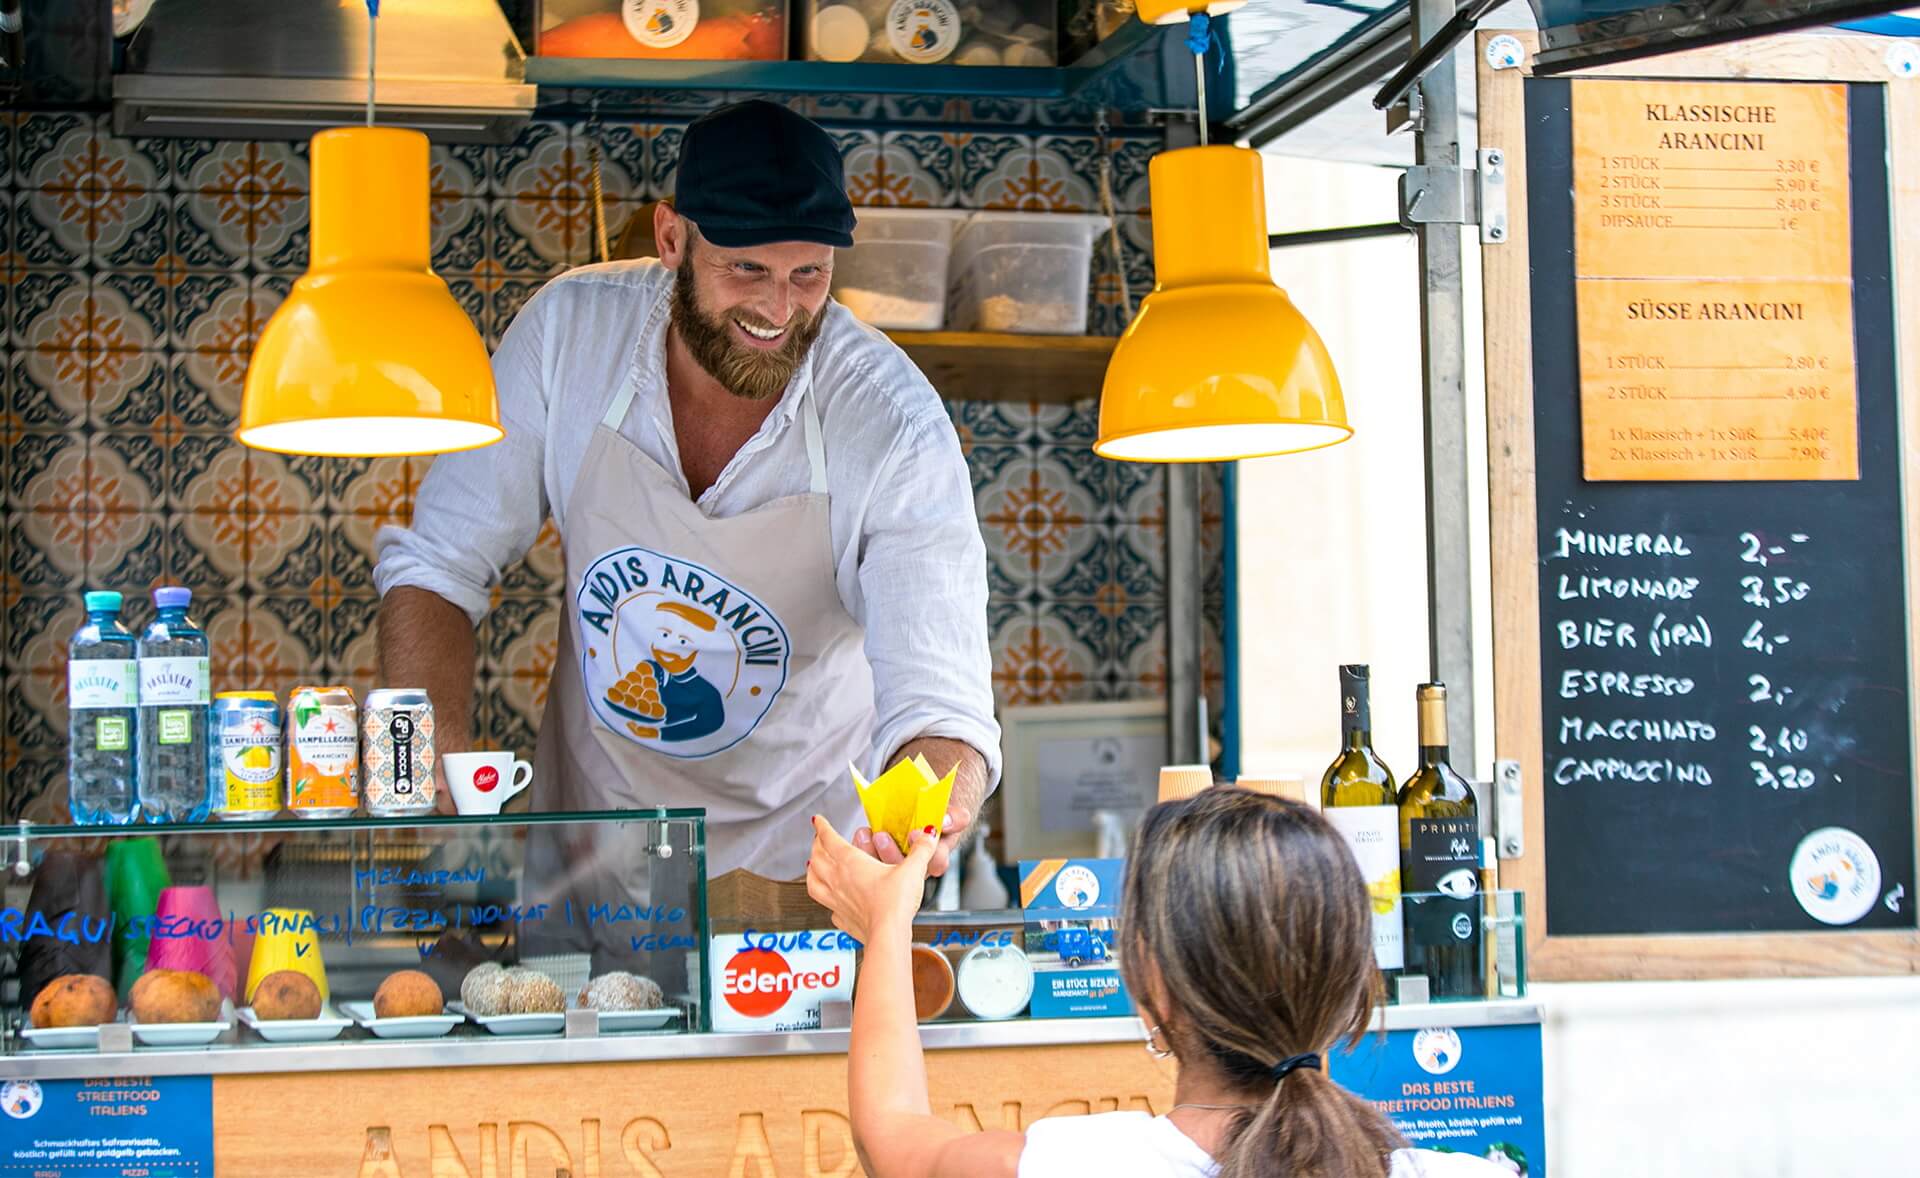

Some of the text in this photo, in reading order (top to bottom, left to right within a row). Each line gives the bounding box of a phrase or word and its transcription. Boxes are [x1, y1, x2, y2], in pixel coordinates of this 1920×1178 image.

[1646, 103, 1776, 123] KLASSISCHE
[1658, 132, 1765, 151] ARANCINI
[1600, 157, 1608, 169] 1
[1612, 155, 1660, 170] STÜCK
[1600, 176, 1609, 189] 2
[1612, 174, 1660, 190] STÜCK
[1600, 195, 1609, 209] 3
[1612, 193, 1661, 209] STÜCK
[1600, 214, 1673, 229] DIPSAUCE
[1628, 298, 1805, 320] SÜSSE ARANCINI
[1617, 354, 1665, 369] STÜCK
[1607, 386, 1616, 399] 2
[1619, 384, 1667, 400] STÜCK
[1609, 428, 1625, 441] 1x
[1629, 427, 1691, 441] Klassisch
[1711, 428, 1727, 441] 1x
[1609, 448, 1627, 461] 2x
[1630, 446, 1693, 461] Klassisch
[1711, 447, 1728, 461] 1x
[1555, 528, 1692, 558] MINERAL
[582, 556, 649, 635] ANDIS
[1557, 573, 1700, 600] LIMONADE
[1557, 618, 1637, 649] BIER
[1559, 669, 1695, 698] ESPRESSO
[1559, 716, 1717, 744] MACCHIATO
[1553, 757, 1713, 785] CAPPUCCINO
[0, 907, 107, 945] RAGU
[361, 904, 448, 937] PIZZA
[587, 902, 686, 926] MANGO
[723, 965, 840, 995] Edenred
[76, 1090, 161, 1103] STREETFOOD
[1402, 1080, 1475, 1096] DAS BESTE
[89, 1104, 148, 1117] ITALIENS
[1371, 1095, 1515, 1113] TREETFOOD ITALIENS
